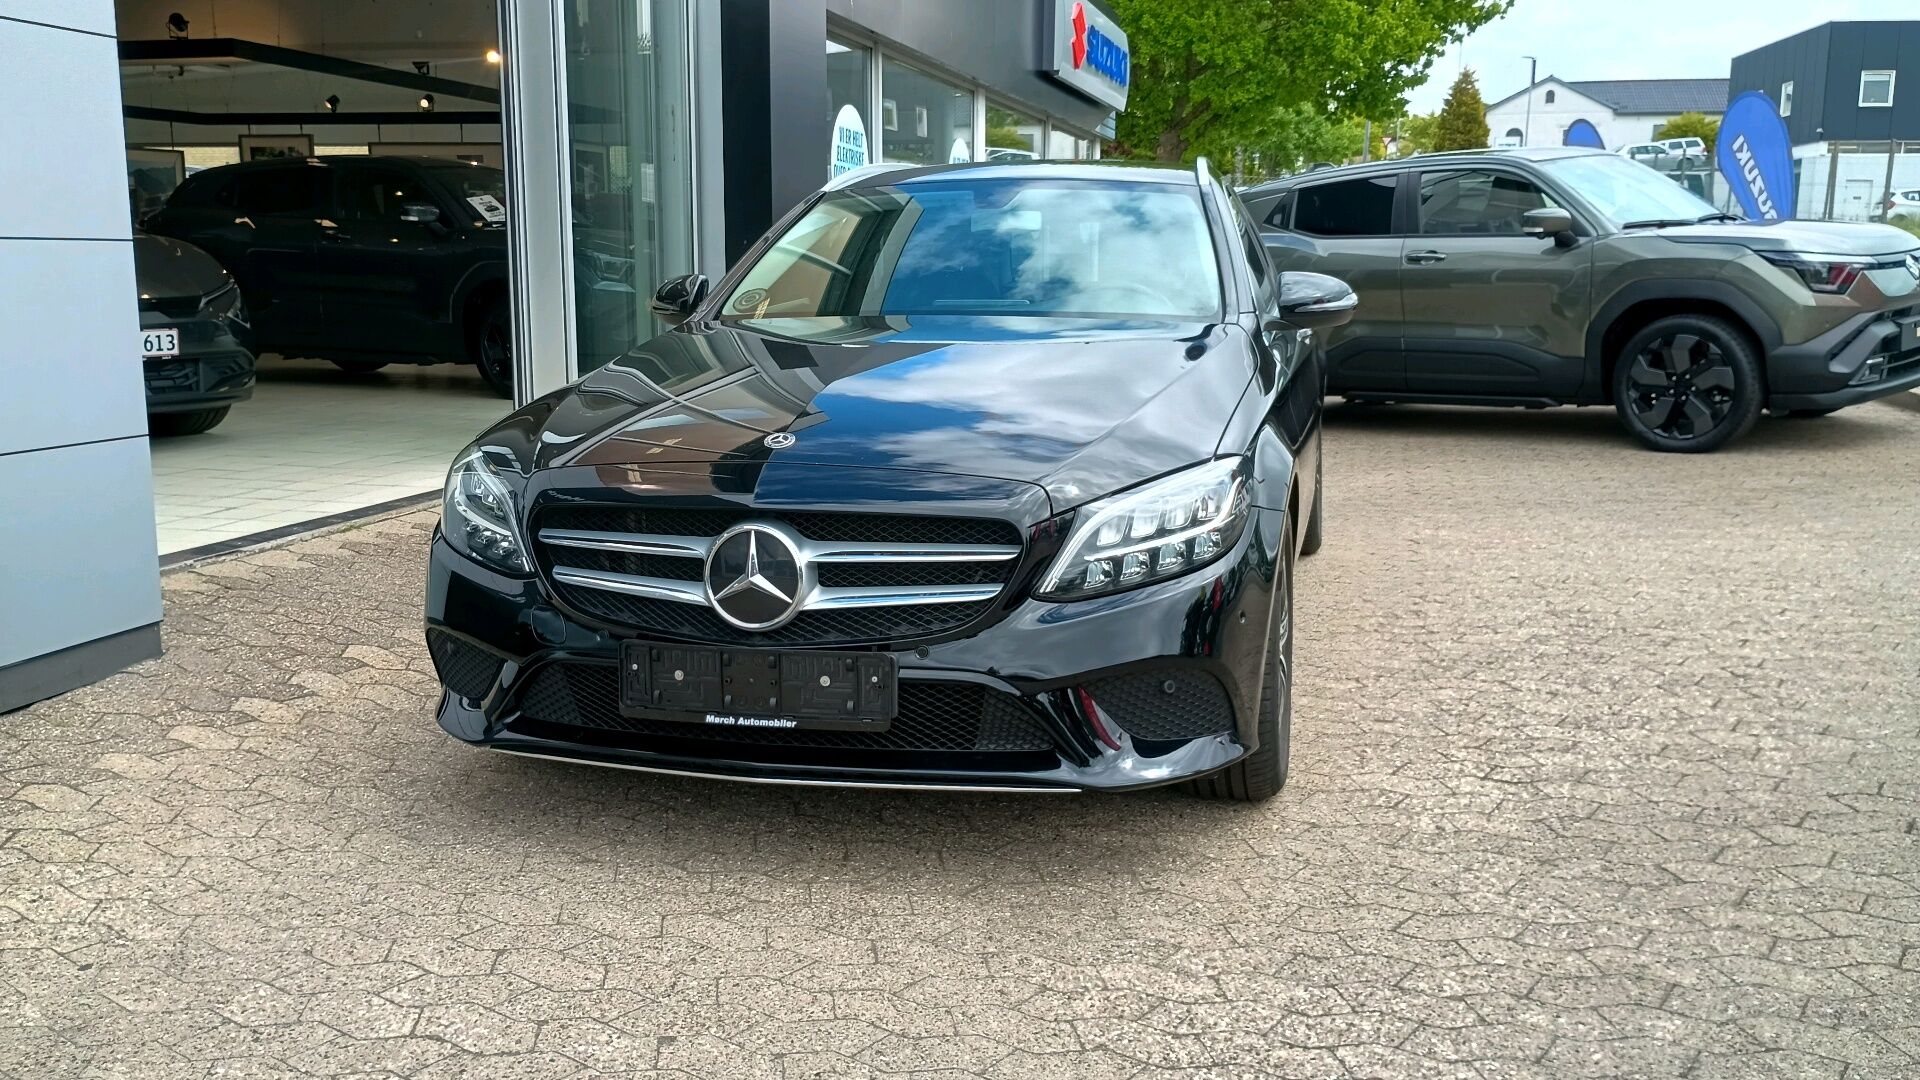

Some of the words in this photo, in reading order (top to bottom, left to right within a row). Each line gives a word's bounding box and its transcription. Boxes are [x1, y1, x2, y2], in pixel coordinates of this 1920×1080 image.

[1086, 25, 1128, 88] SUZUKI
[846, 128, 852, 145] ER
[853, 130, 863, 148] HELT
[143, 334, 176, 352] 613
[705, 714, 735, 725] Mørch
[737, 716, 797, 728] Automobiler
